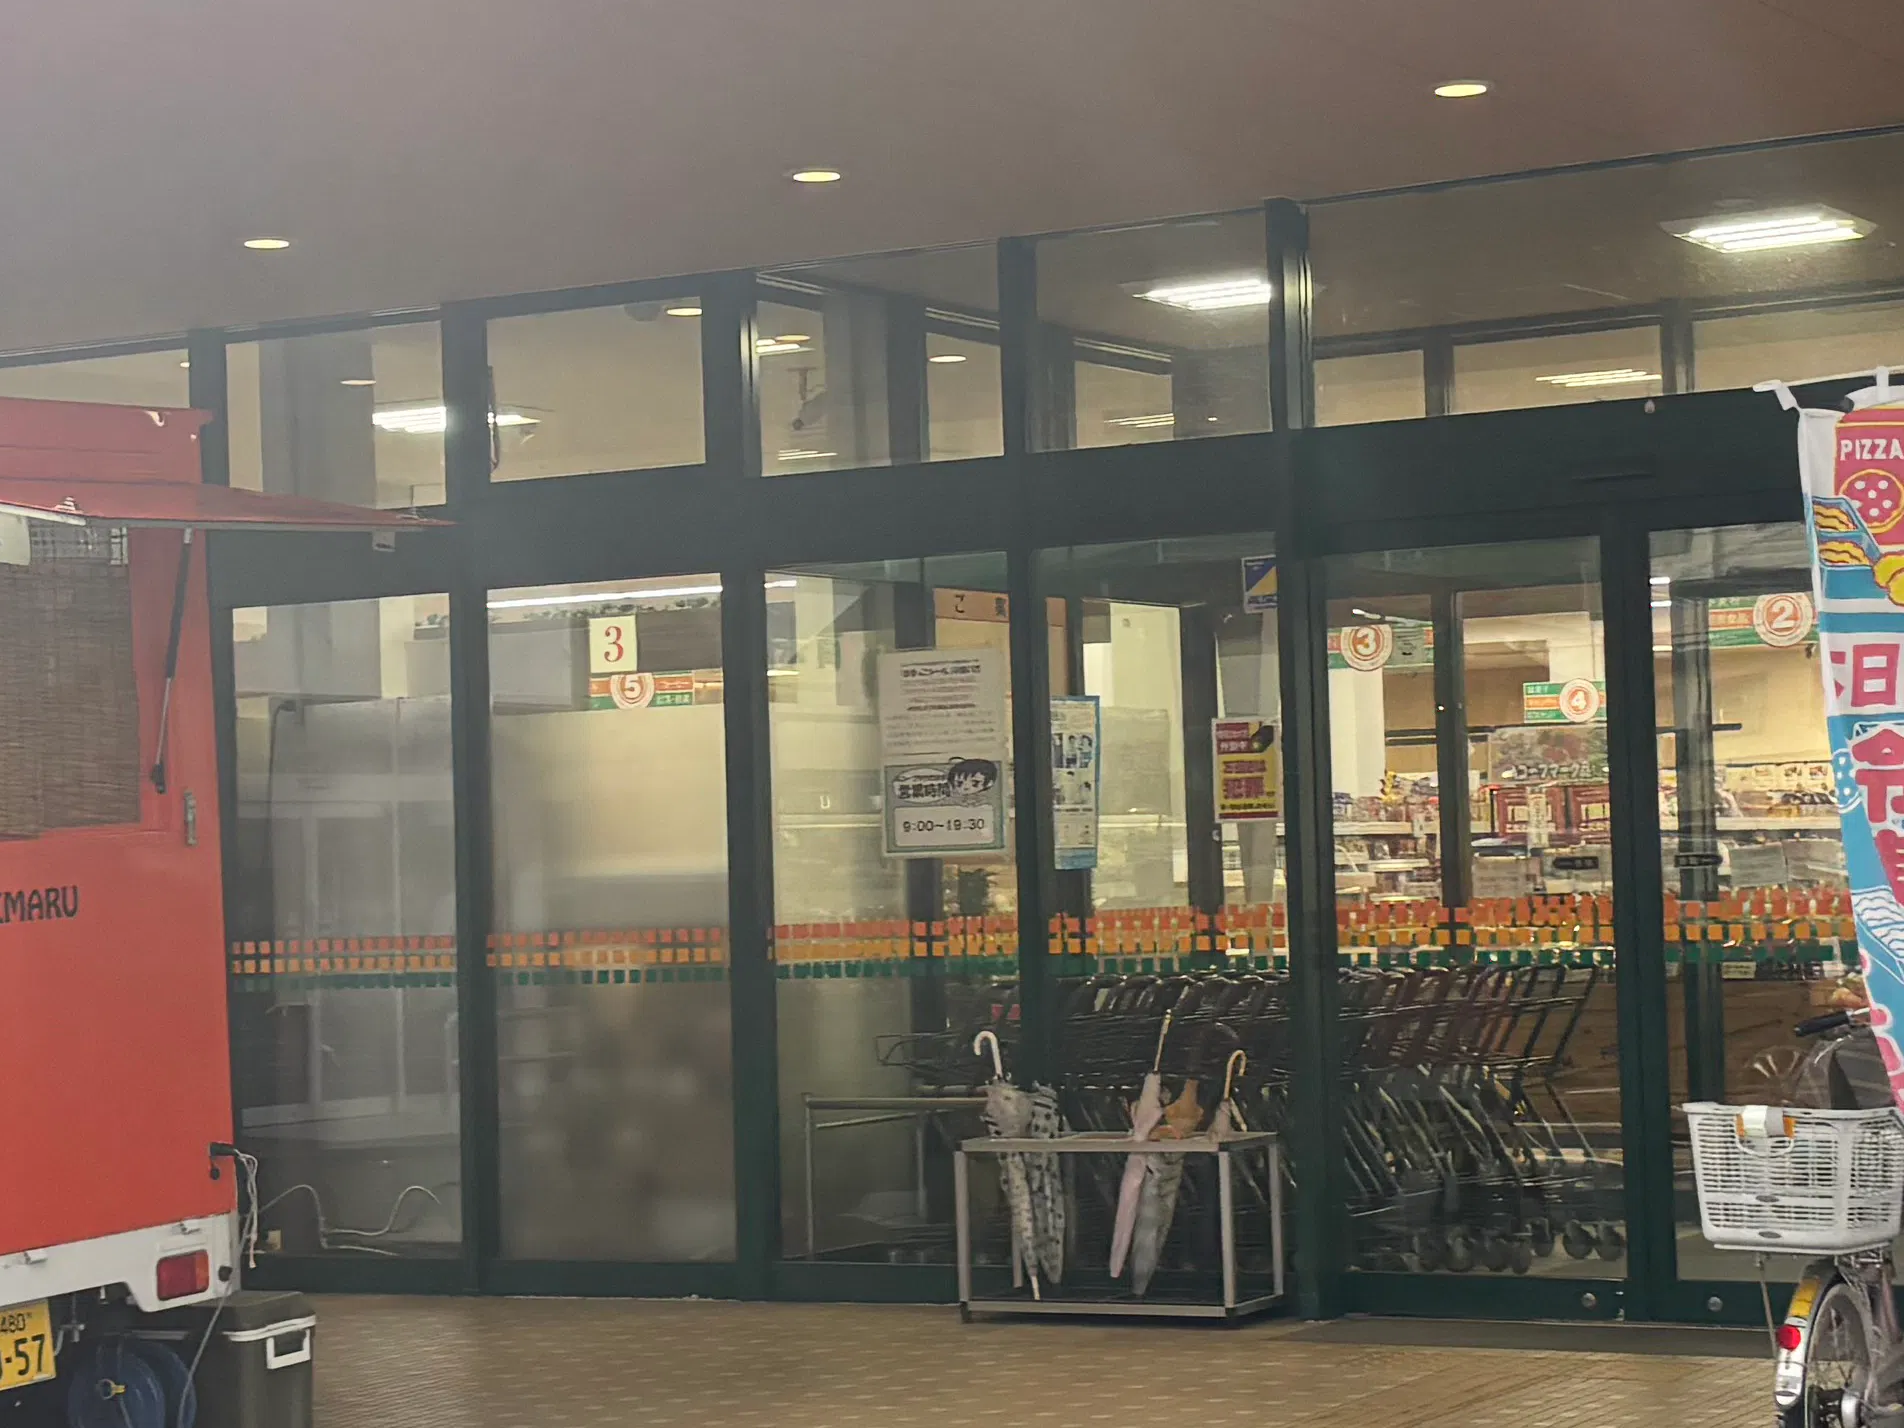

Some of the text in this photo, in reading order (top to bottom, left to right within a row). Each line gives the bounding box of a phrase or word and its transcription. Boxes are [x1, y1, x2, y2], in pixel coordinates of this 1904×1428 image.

[1839, 438, 1904, 462] PIZZA
[1770, 600, 1795, 629] 2
[603, 625, 624, 663] 3
[1355, 626, 1377, 655] 3
[624, 674, 643, 700] 5
[1571, 690, 1587, 710] 4
[0, 1312, 26, 1333] 480
